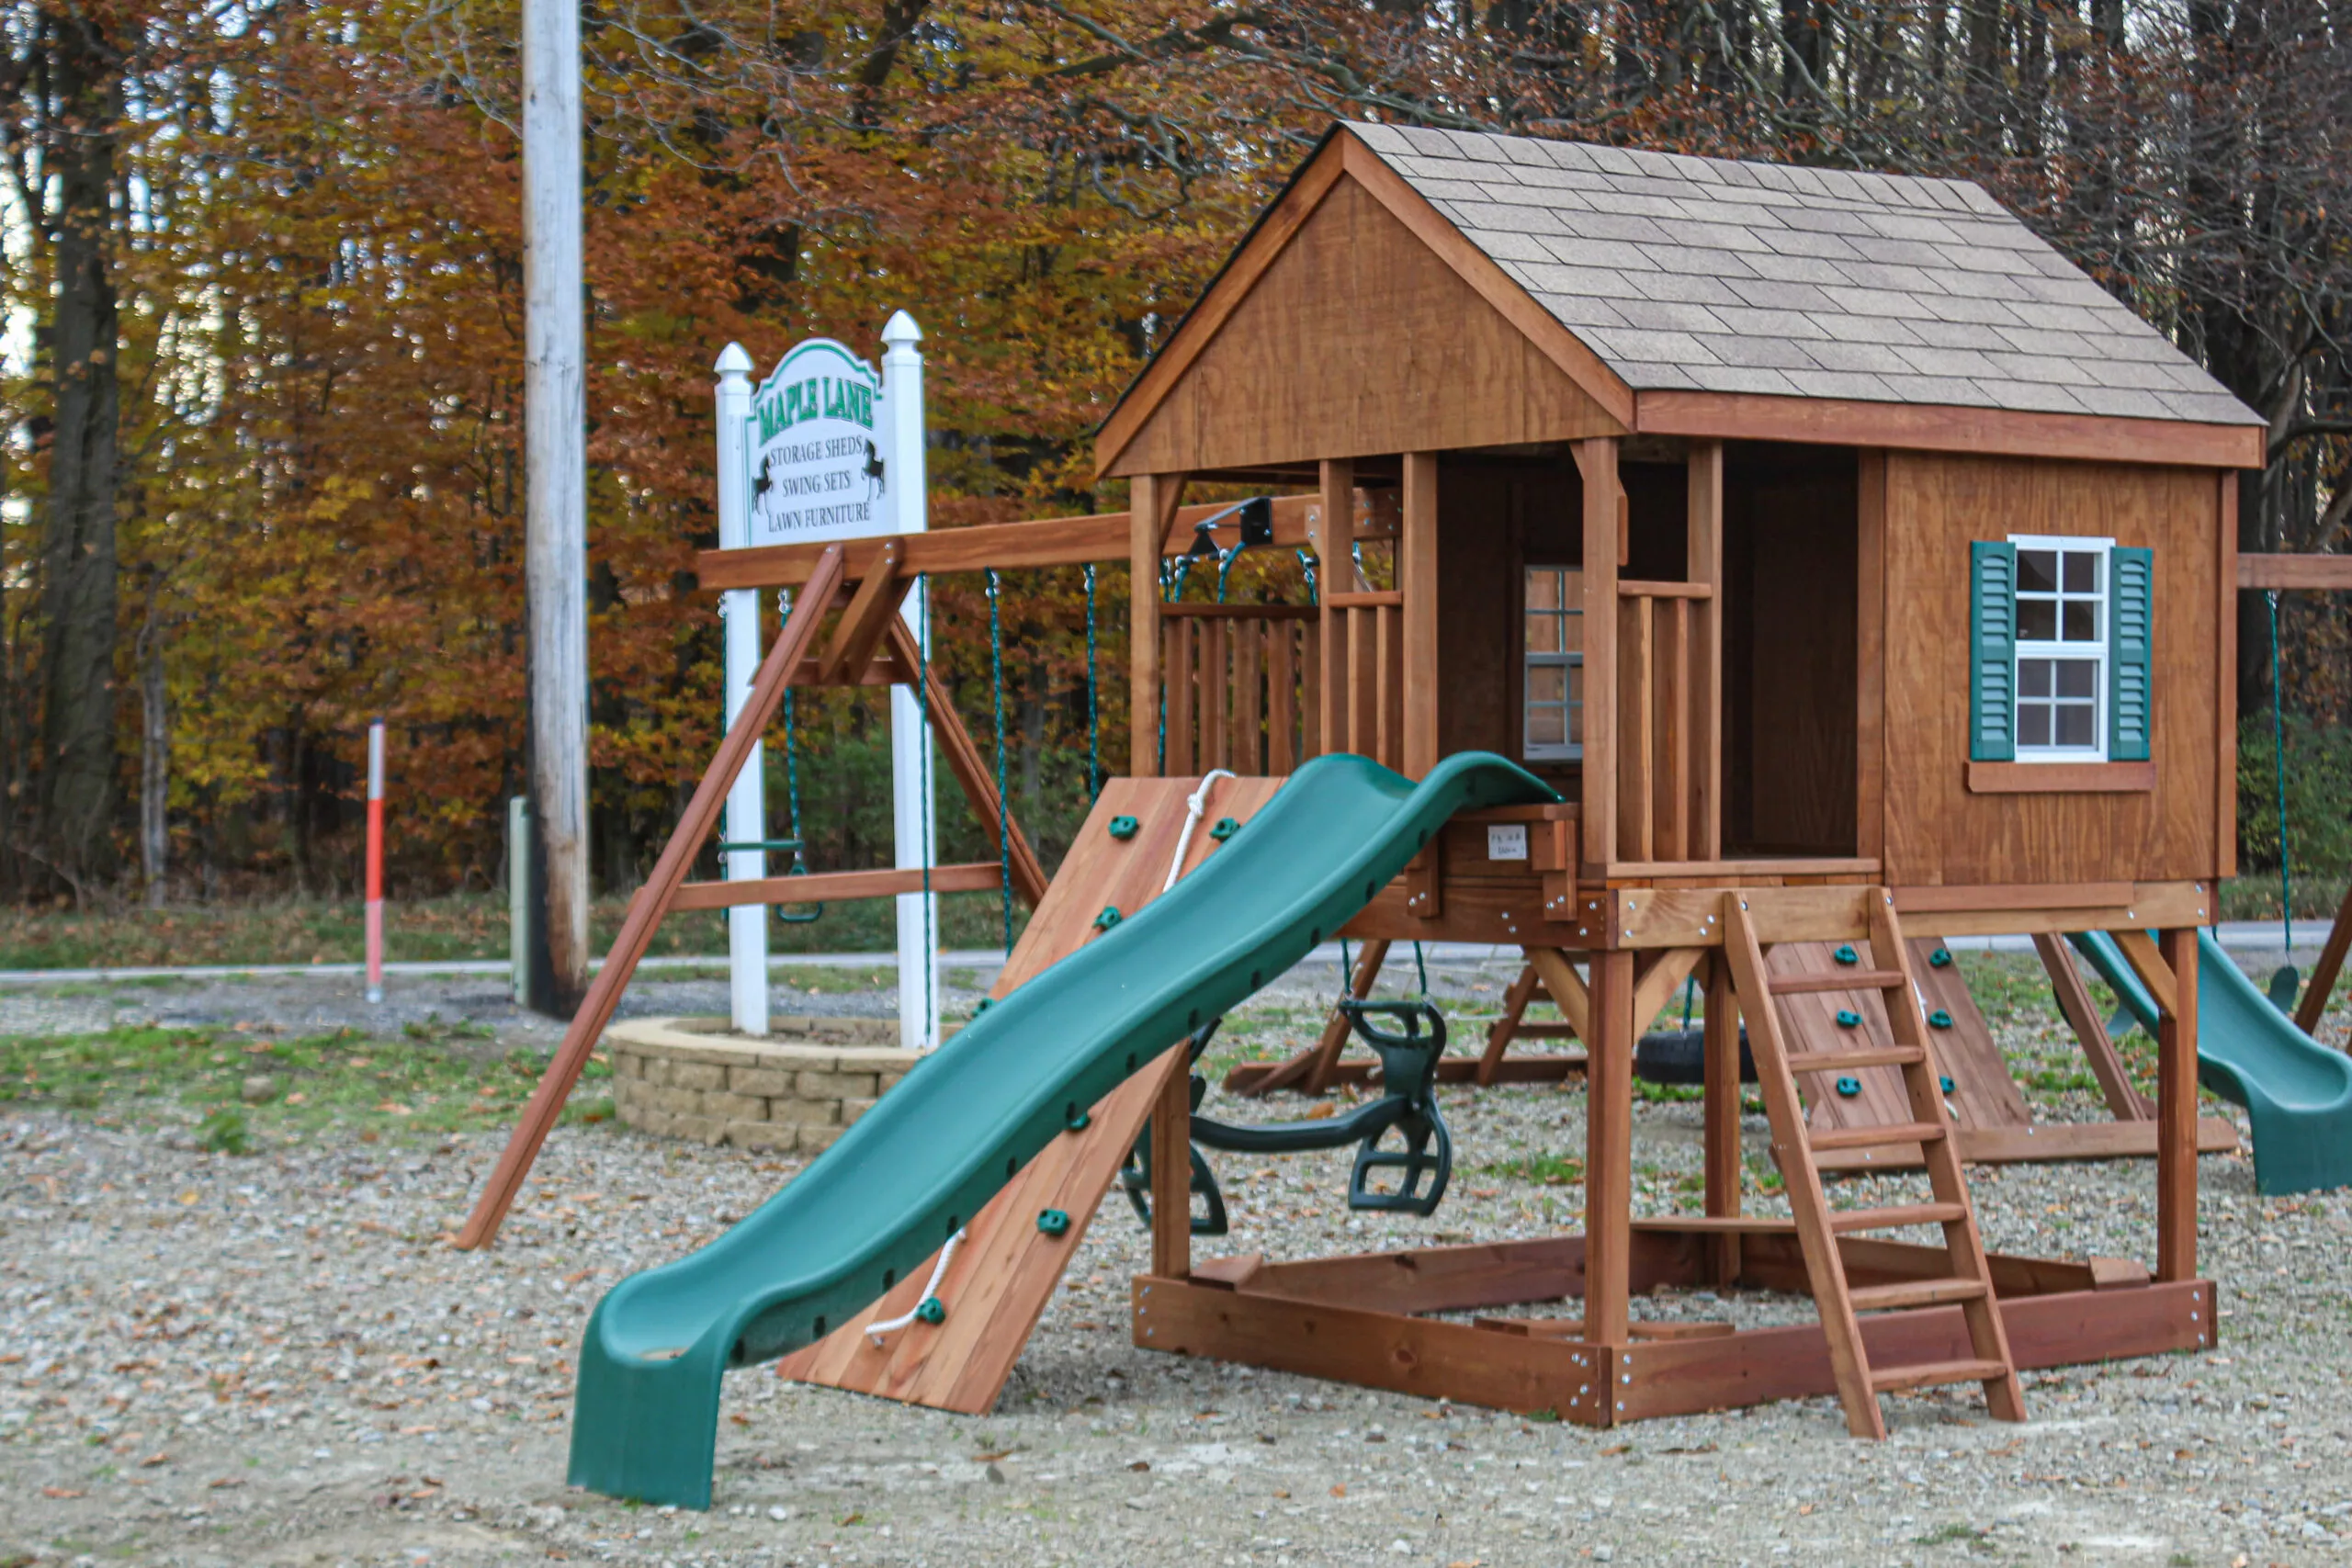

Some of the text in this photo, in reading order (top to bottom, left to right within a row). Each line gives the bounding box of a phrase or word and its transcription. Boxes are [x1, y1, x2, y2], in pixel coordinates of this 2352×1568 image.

[758, 377, 874, 447] MAPLE LANE
[770, 435, 863, 468] STORAGE SHEDS
[782, 470, 851, 498] SWING SETS
[768, 502, 870, 533] LAWN FURNITURE
